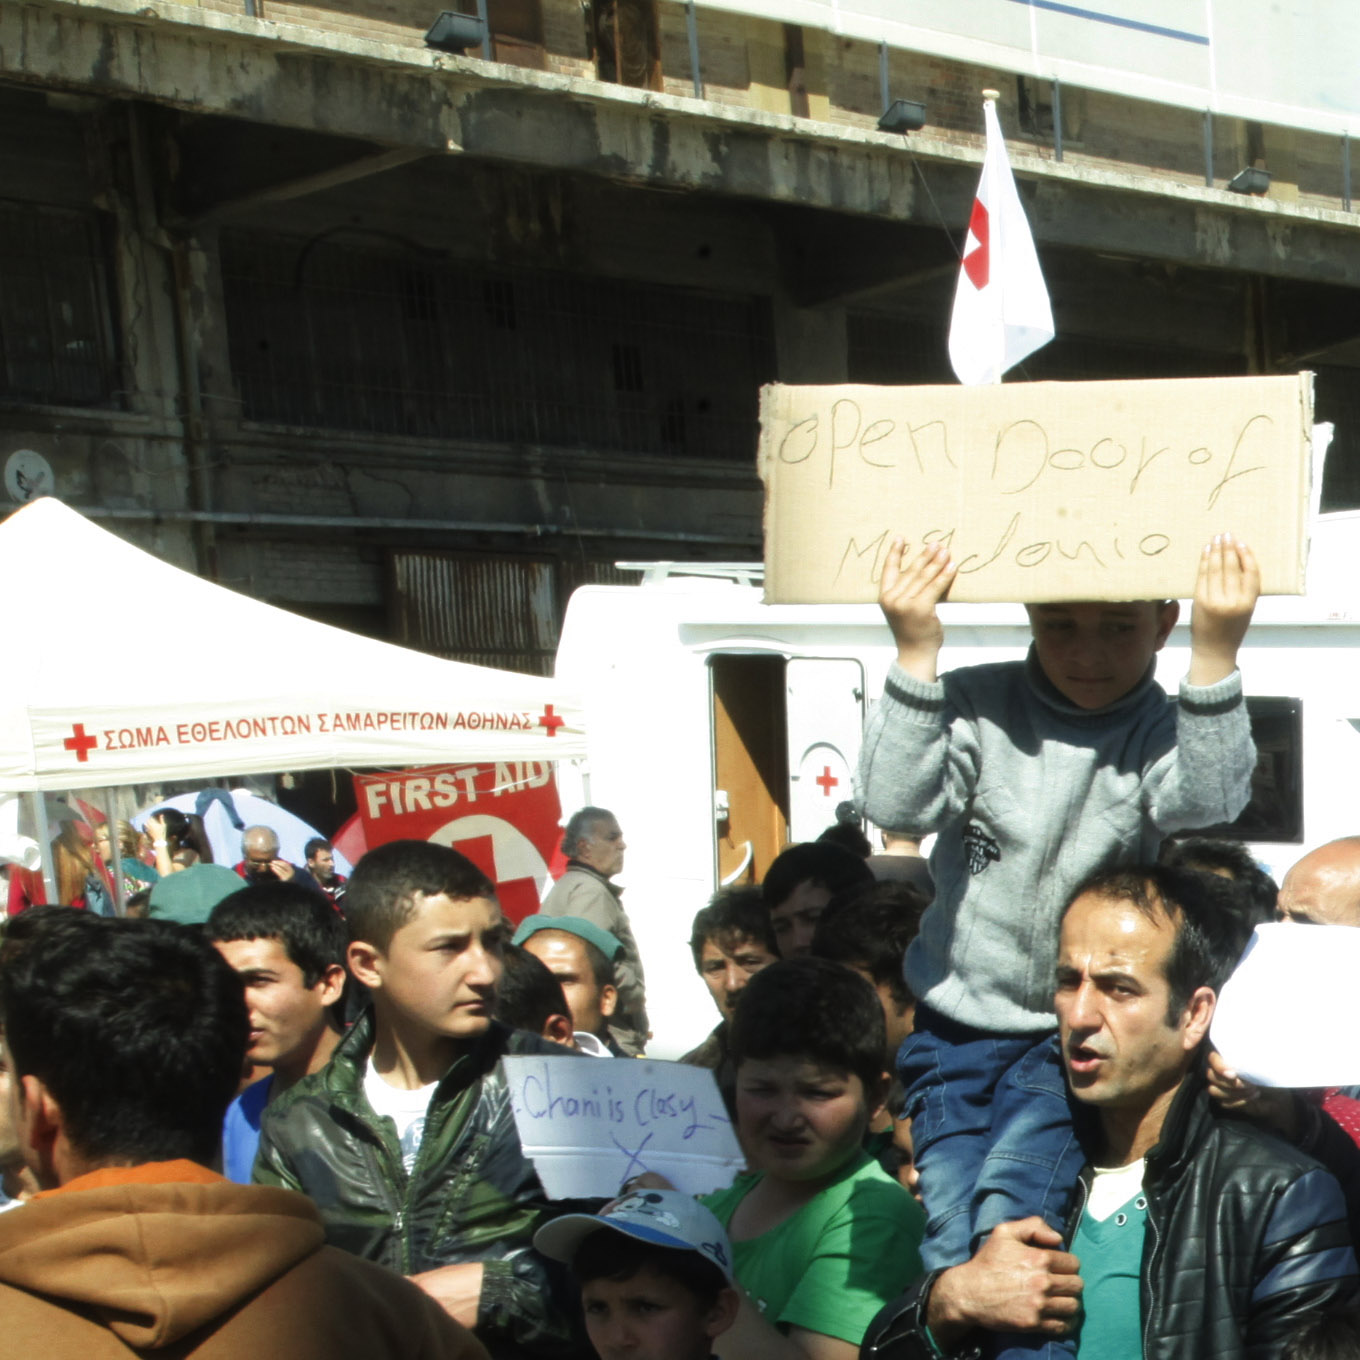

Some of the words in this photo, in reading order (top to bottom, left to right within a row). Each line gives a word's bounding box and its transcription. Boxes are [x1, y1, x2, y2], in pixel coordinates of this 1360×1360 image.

[104, 725, 171, 752] ΣΩΜΑ
[176, 714, 311, 744] ΕΘΕΛΟΝΤΩΝ
[317, 711, 449, 733] ΣΑΜΑΡΕΙΤΩΝ
[452, 711, 533, 731] ΑΘΗΝΑΣ
[364, 767, 480, 819] FIRST
[492, 761, 551, 798] AID
